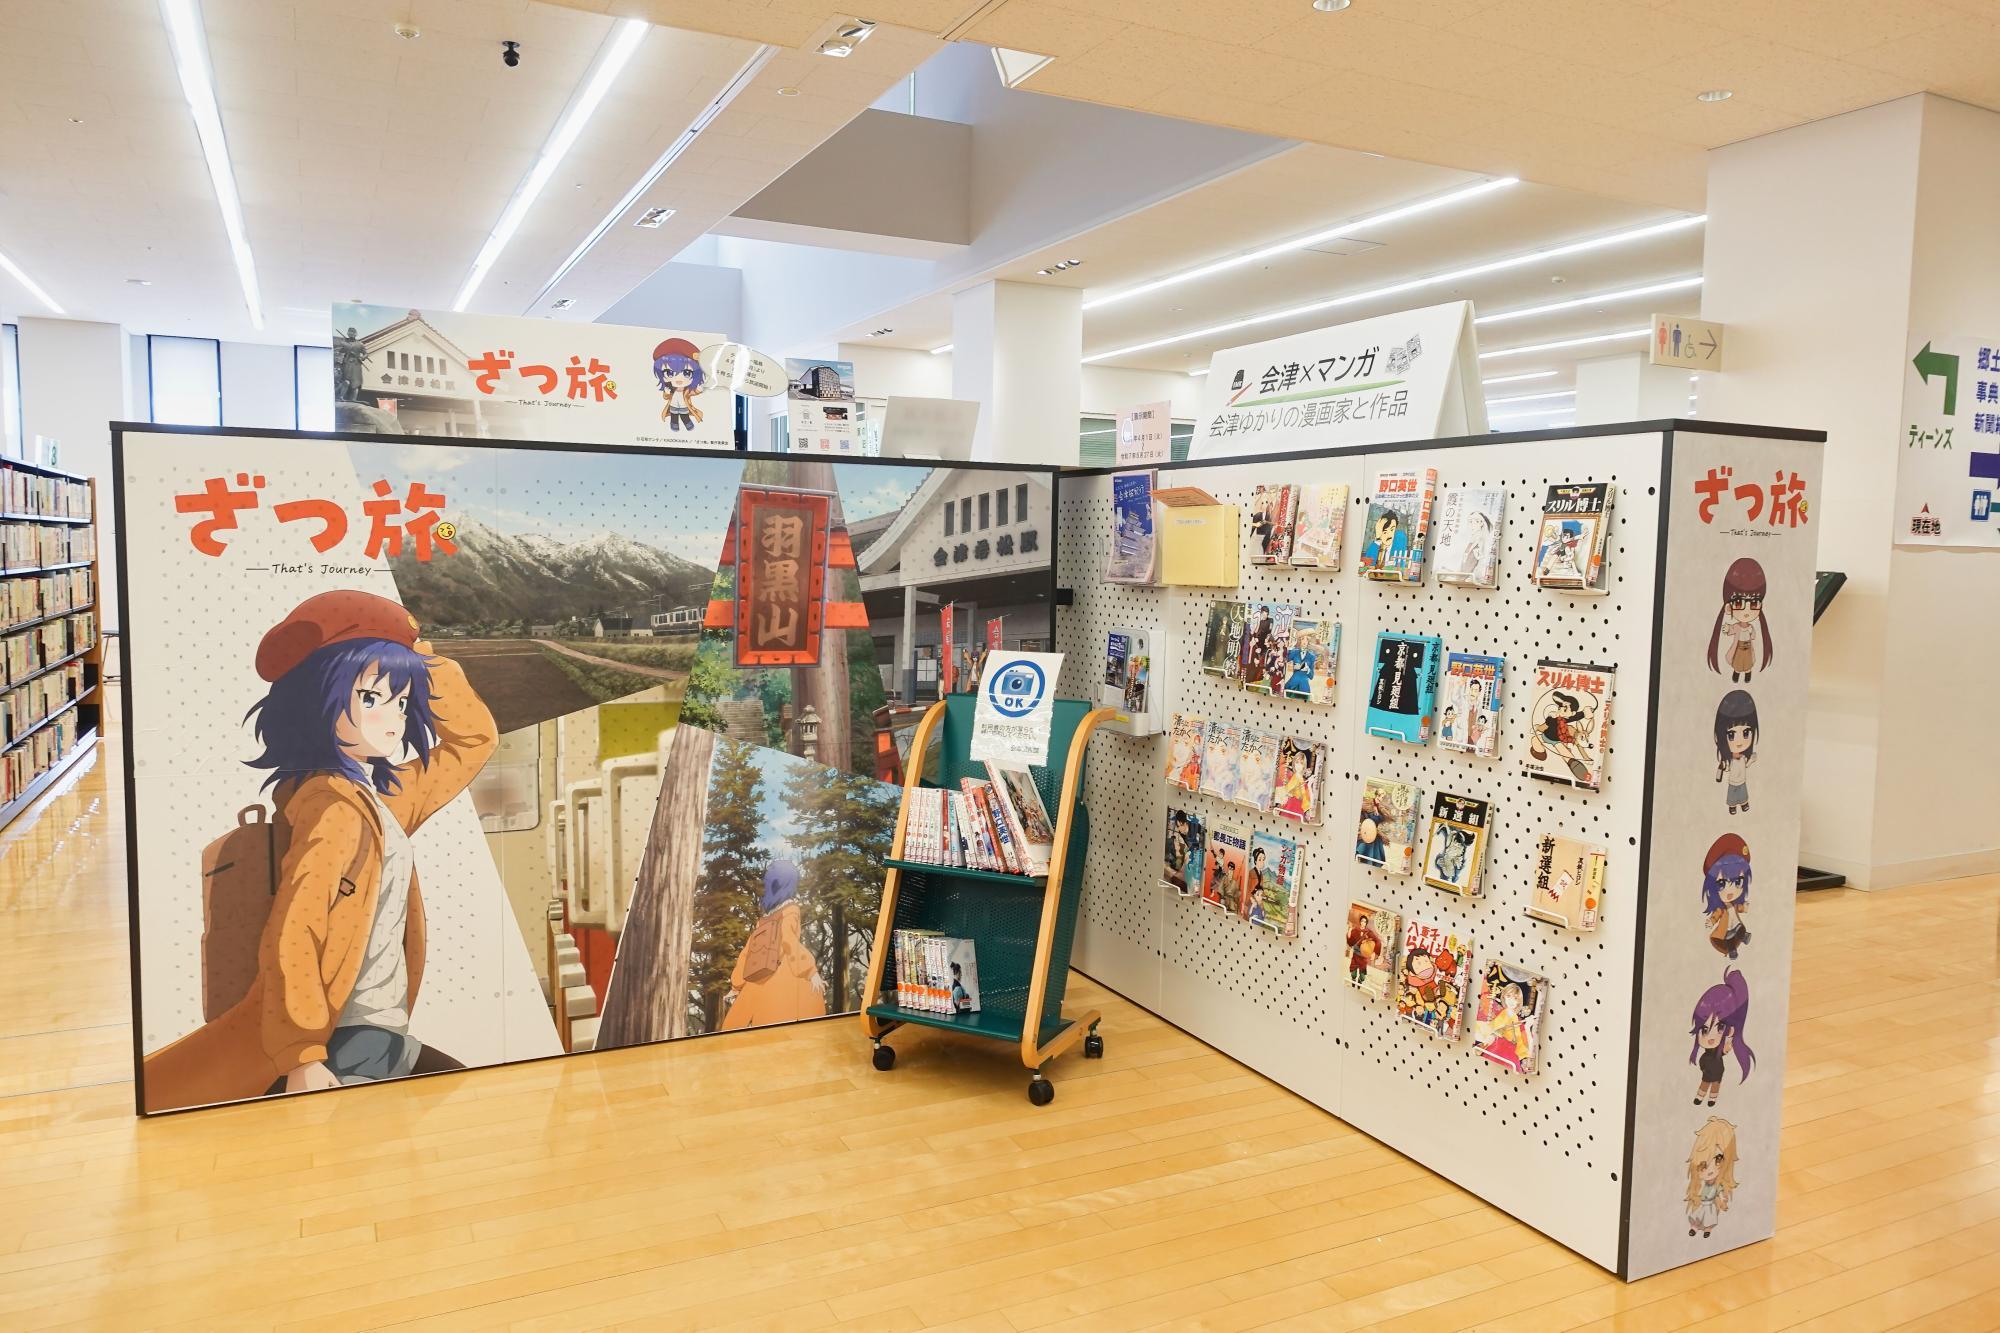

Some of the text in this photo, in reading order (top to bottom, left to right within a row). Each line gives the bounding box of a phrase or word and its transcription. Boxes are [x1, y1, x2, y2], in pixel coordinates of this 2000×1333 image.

[467, 349, 618, 402] ざつ旅
[1259, 345, 1381, 395] 会津×マンガ
[1208, 389, 1409, 438] 会津ゆかりの漫画家と作品
[1908, 424, 1954, 450] ティーンズ
[1545, 497, 1602, 513] スリル博士
[1694, 465, 1809, 529] ざつ旅
[174, 472, 459, 562] ざつ旅
[1911, 517, 1942, 536] 現在地
[272, 562, 373, 578] That's Journey
[756, 514, 804, 648] 羽黒山
[1536, 670, 1606, 695] スリル博士
[1003, 696, 1025, 709] OK
